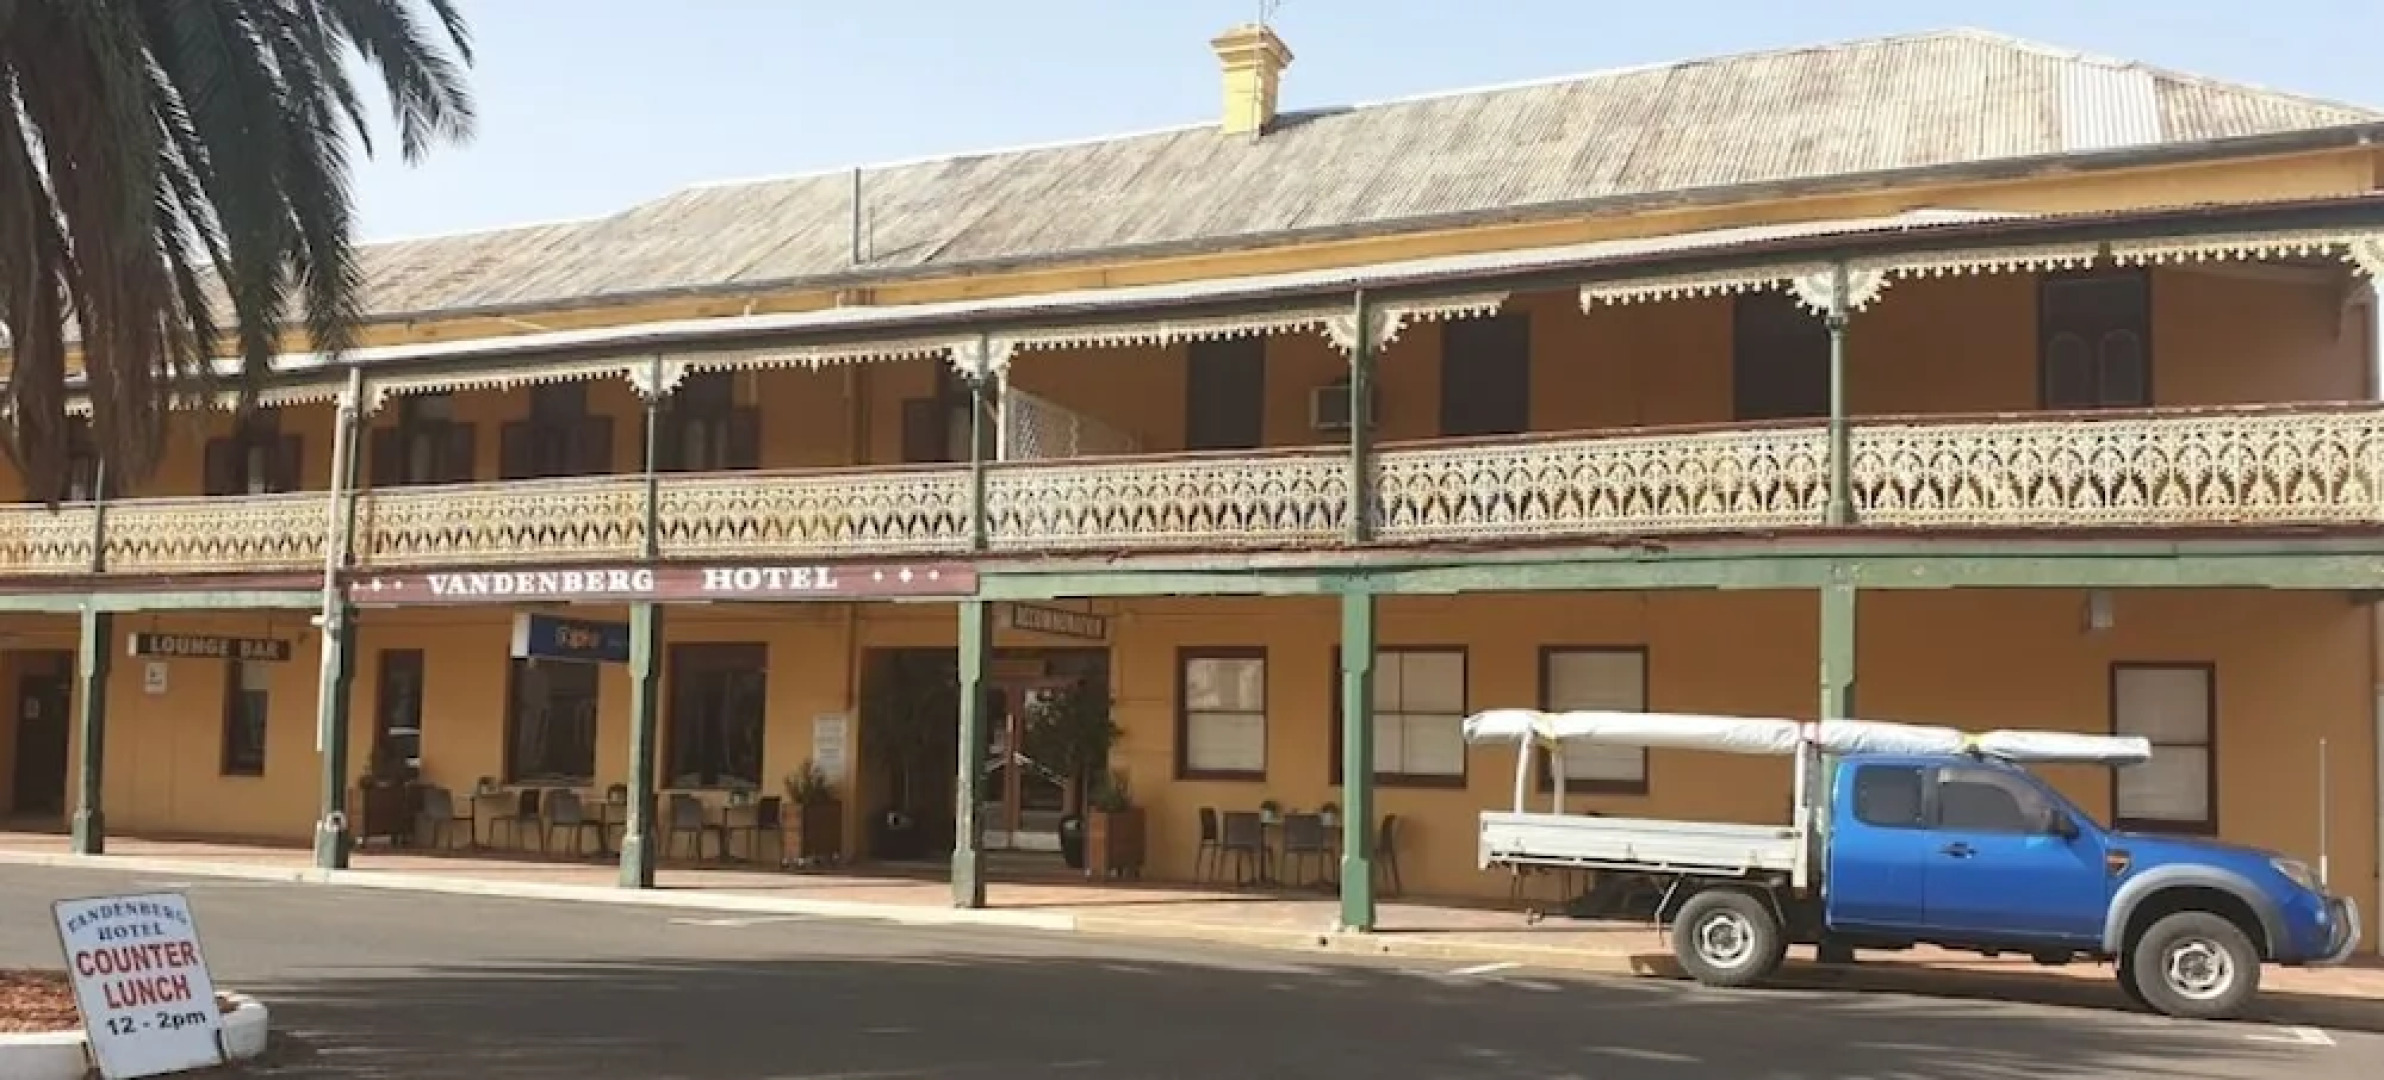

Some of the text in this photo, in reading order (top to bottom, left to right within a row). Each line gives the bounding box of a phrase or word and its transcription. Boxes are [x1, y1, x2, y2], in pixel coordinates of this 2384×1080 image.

[428, 566, 838, 595] VANDENBERG HOTEL
[151, 634, 280, 657] LOUNGE BAR
[98, 922, 165, 940] HOTEL
[75, 941, 198, 977] COUNTER
[103, 974, 192, 1009] LUNCH
[107, 1016, 136, 1036] 12
[156, 1010, 207, 1029] 2pm
